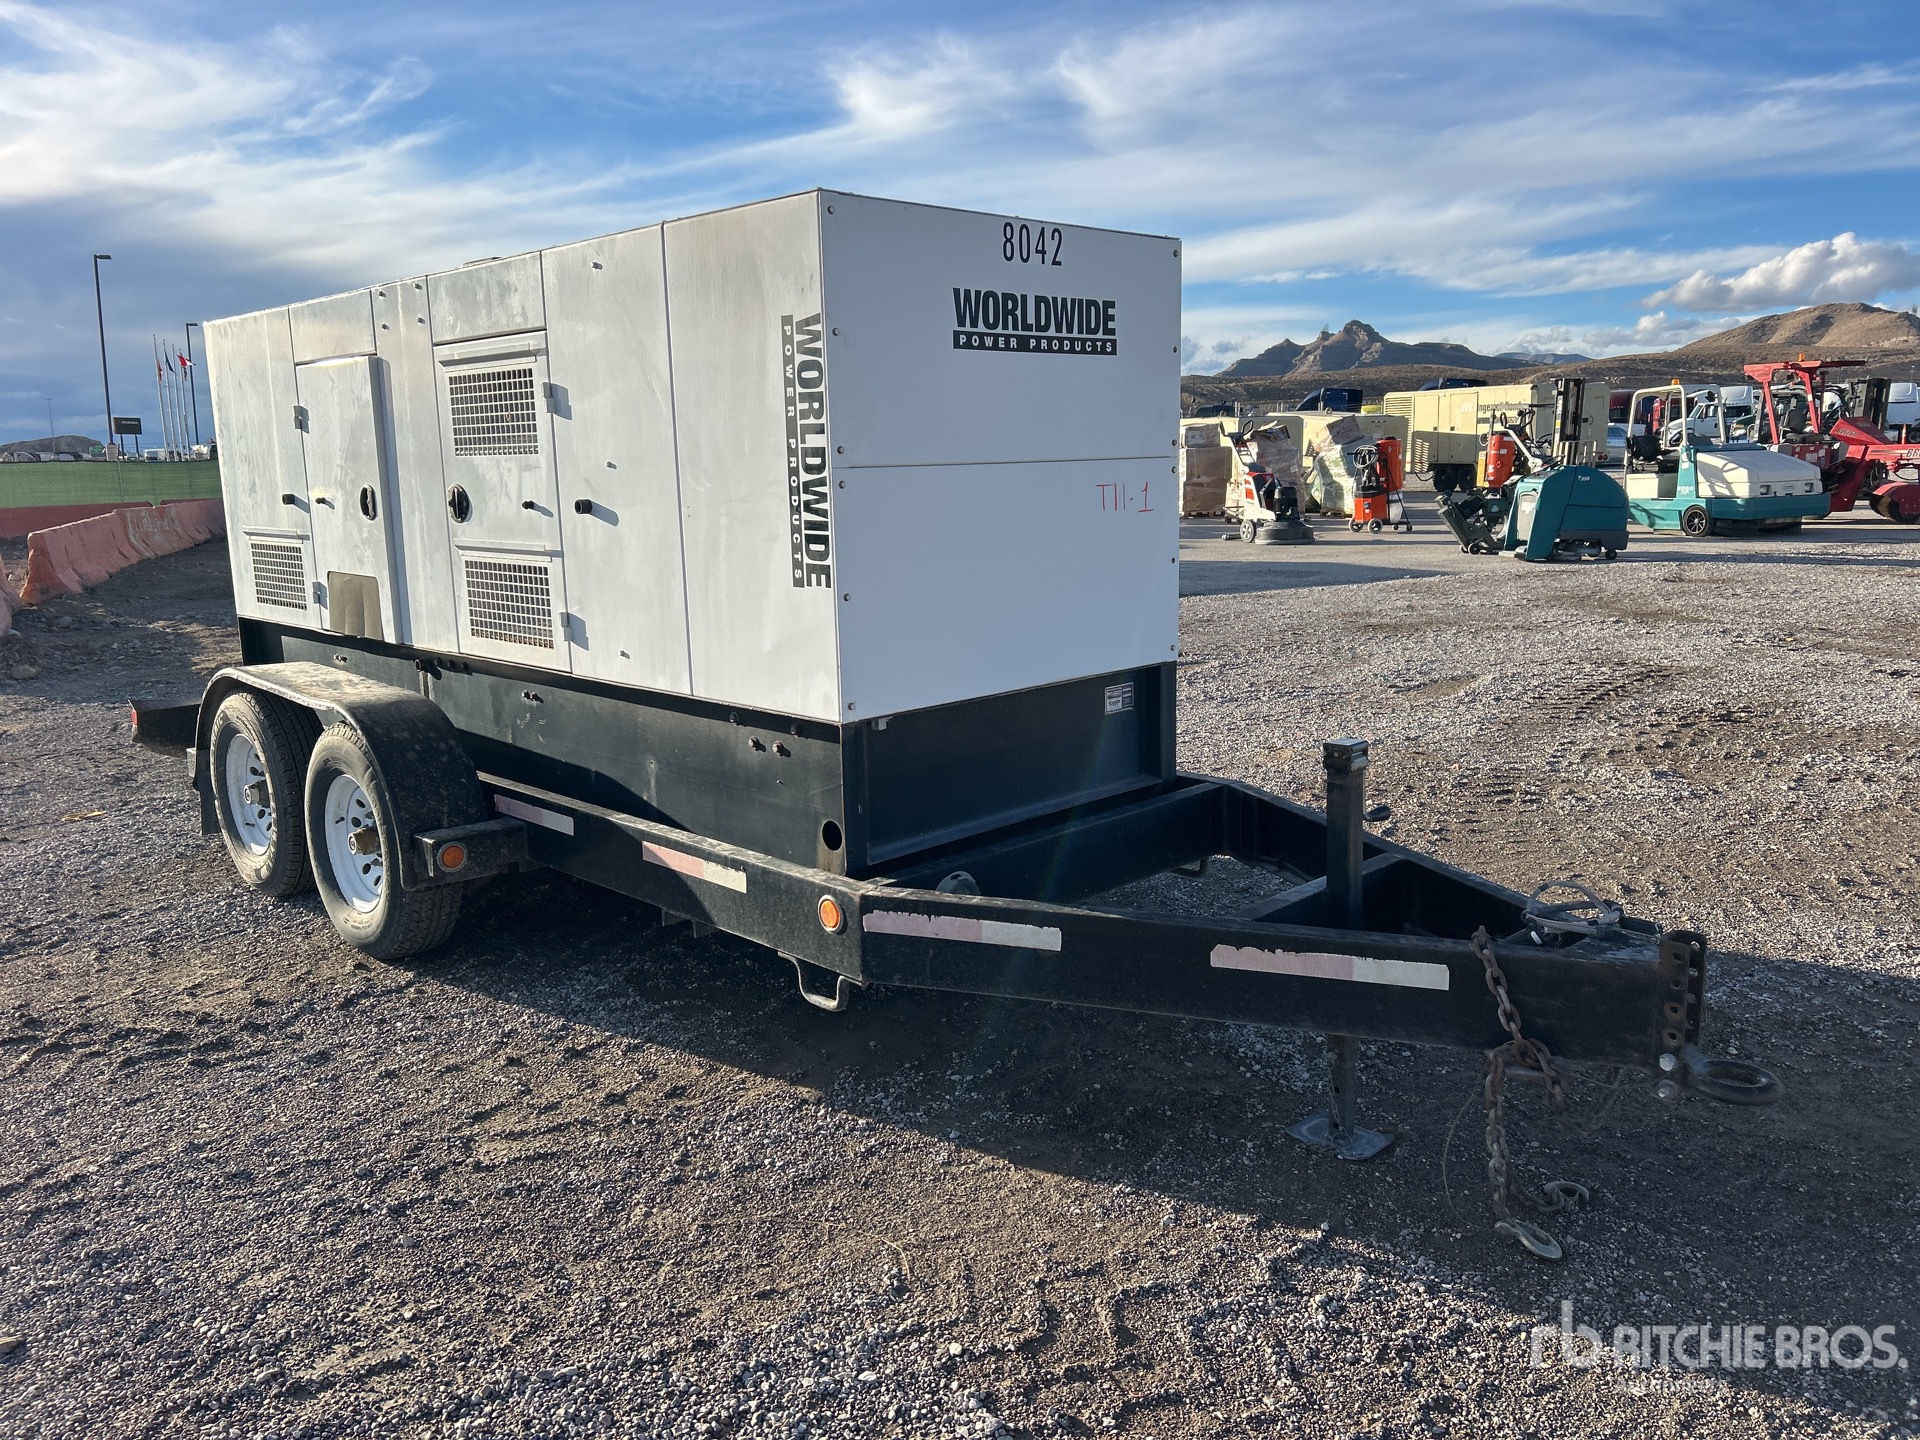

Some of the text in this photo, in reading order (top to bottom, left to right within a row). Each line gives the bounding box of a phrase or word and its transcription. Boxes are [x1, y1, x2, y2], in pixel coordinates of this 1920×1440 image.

[1002, 221, 1063, 267] 8042
[952, 287, 1117, 337] WORLDWIDE
[959, 334, 1113, 353] POWER PRODUCTS
[782, 324, 803, 580] POWER PRODUCTS
[794, 312, 832, 589] WORLDWIDE
[1906, 448, 1920, 458] BR
